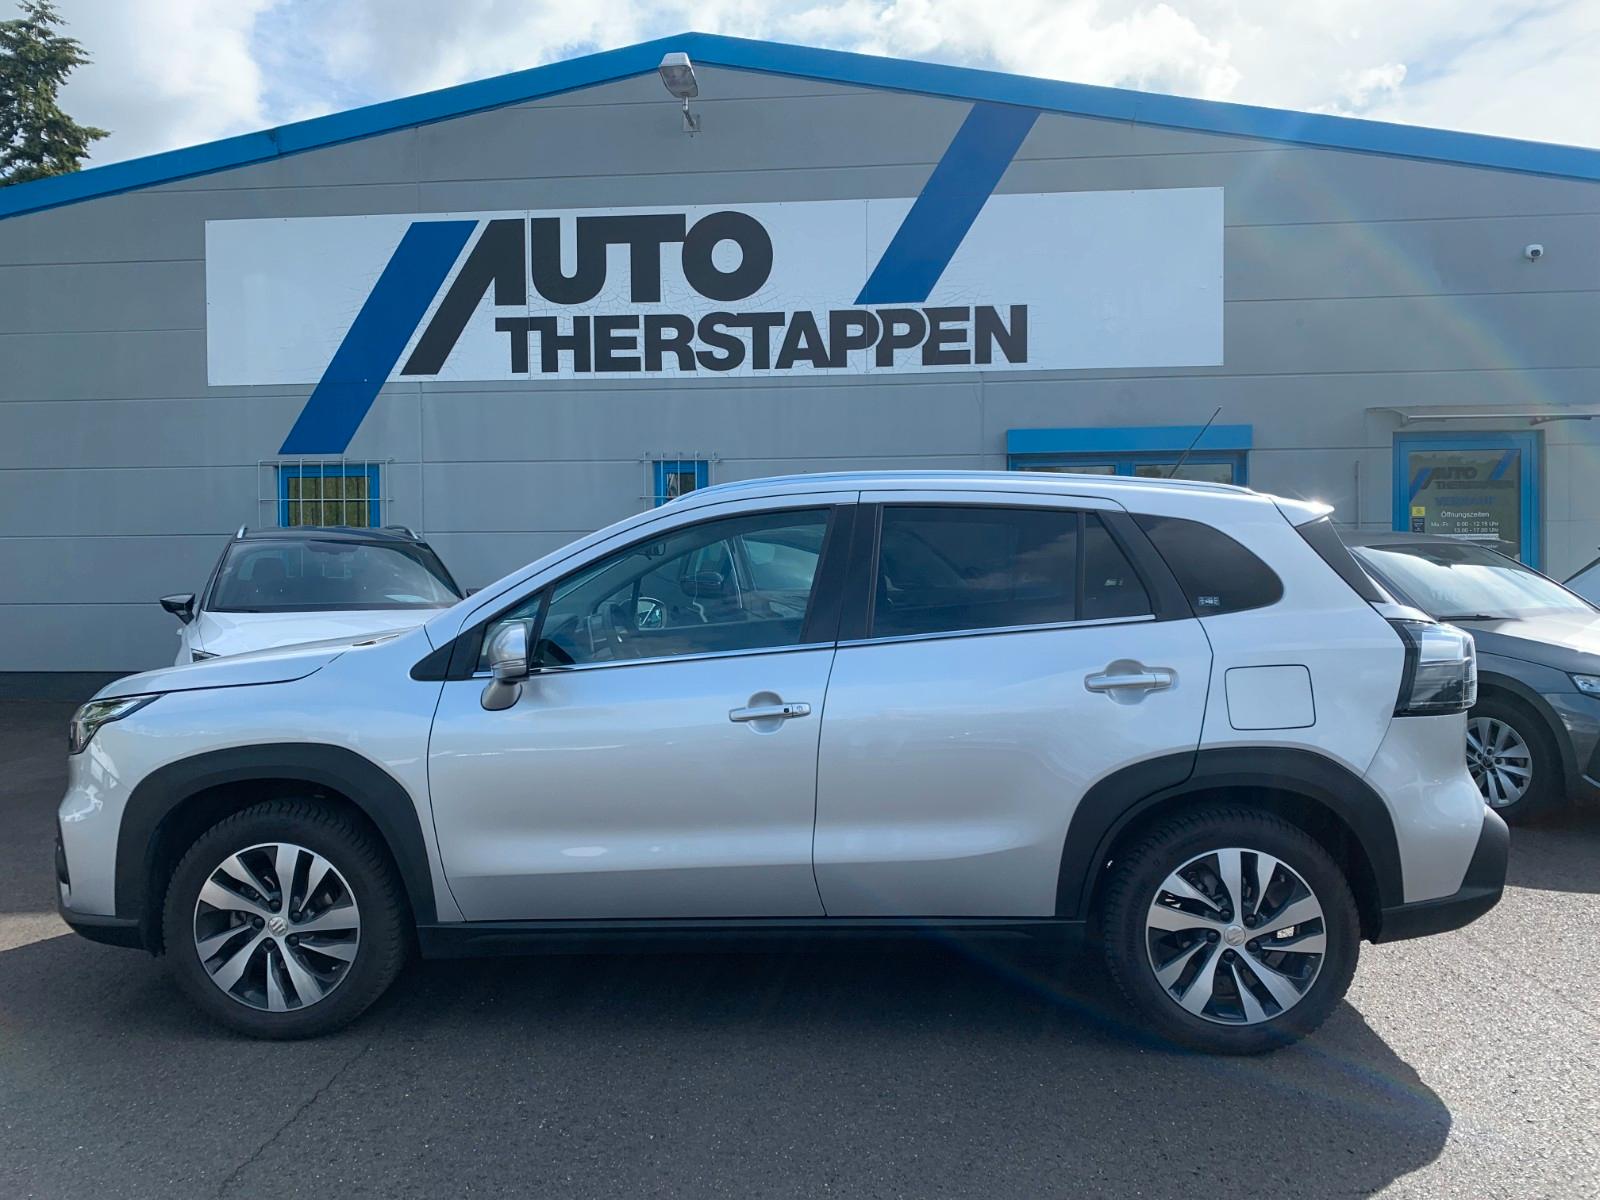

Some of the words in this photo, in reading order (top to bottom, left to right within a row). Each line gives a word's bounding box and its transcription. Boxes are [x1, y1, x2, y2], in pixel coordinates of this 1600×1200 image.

[400, 211, 773, 375] AUTO
[495, 304, 1028, 374] THERSTAPPEN
[1441, 510, 1490, 518] Öffnungszeiten
